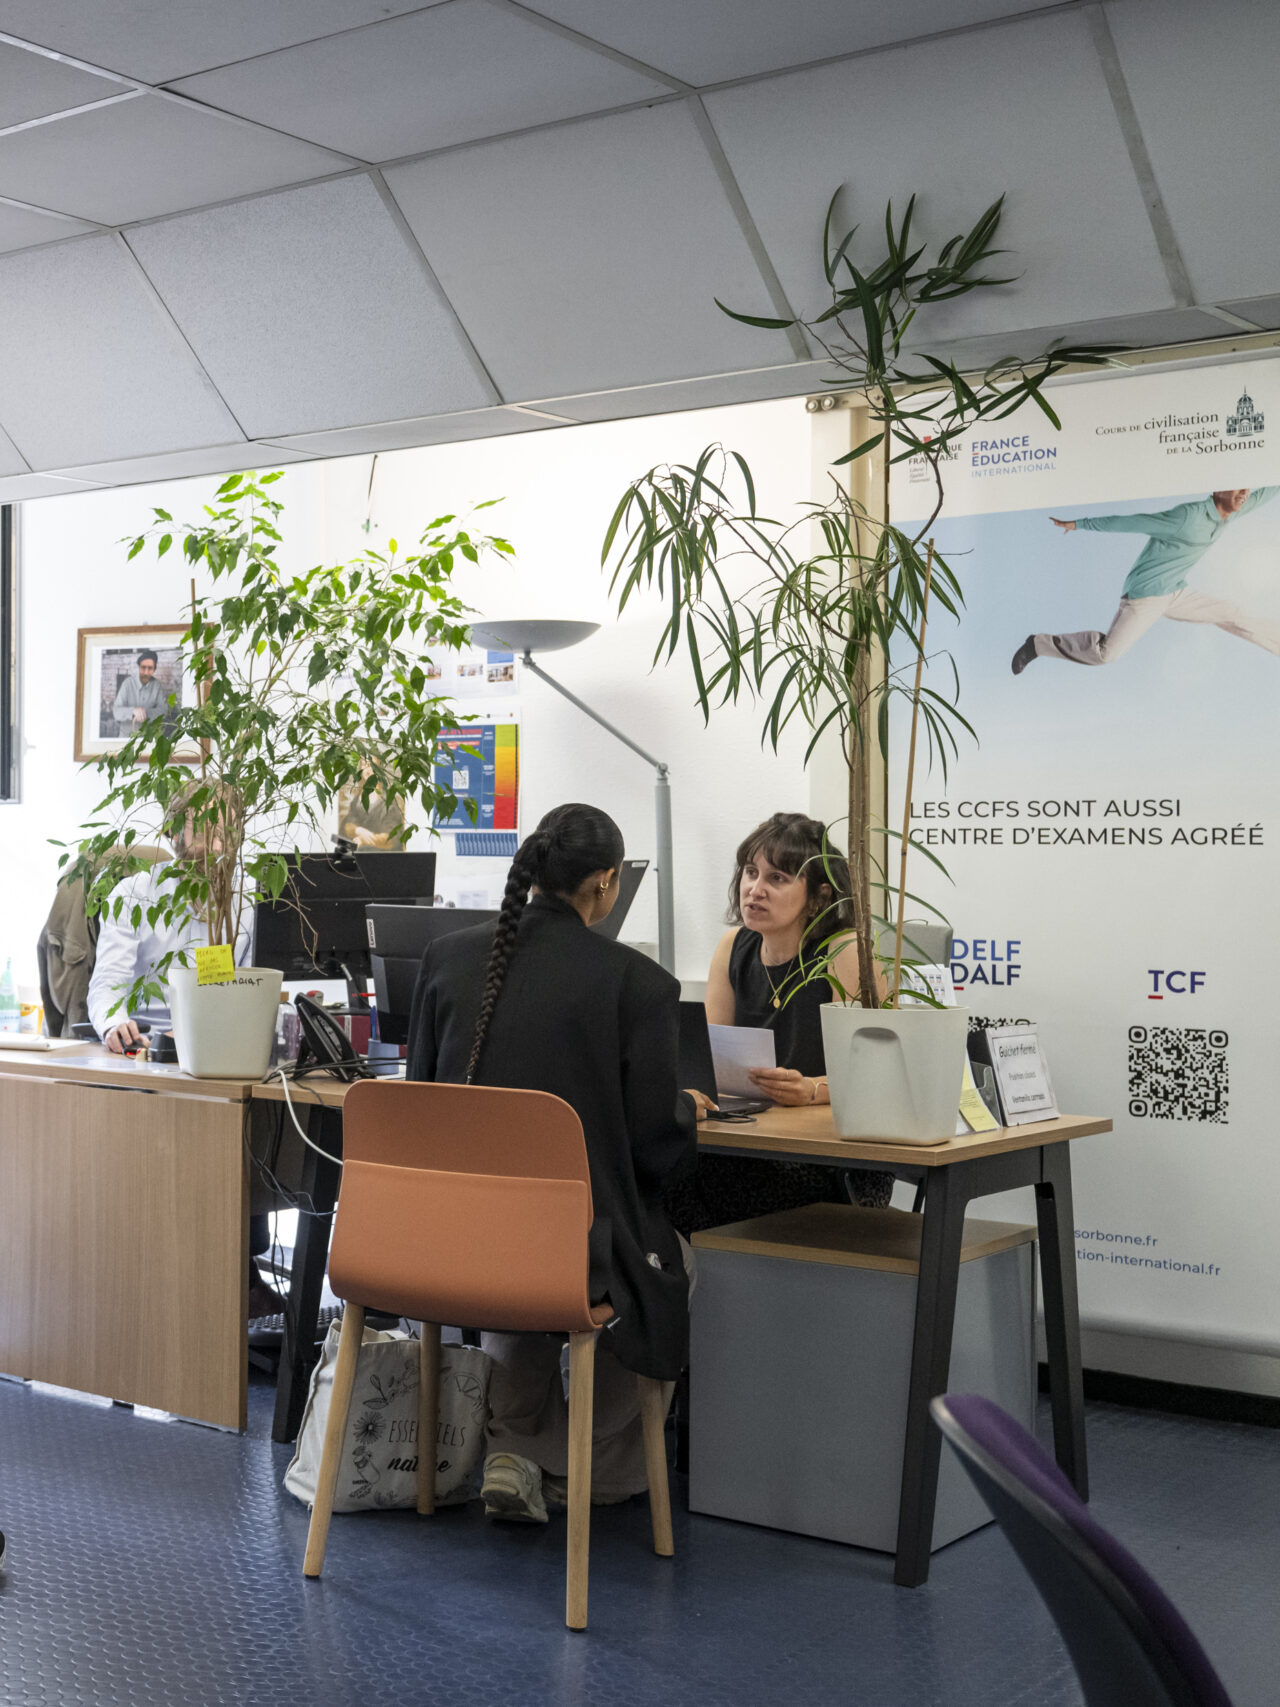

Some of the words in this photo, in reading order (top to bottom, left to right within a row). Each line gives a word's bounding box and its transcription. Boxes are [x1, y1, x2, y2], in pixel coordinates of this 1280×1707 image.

[1144, 412, 1219, 430] civilisation
[972, 436, 1029, 452] FRANCE
[1159, 427, 1220, 444] française
[1195, 439, 1265, 455] Sorbonne
[972, 462, 1056, 478] INTERNATIONAL
[910, 802, 950, 819] LES
[957, 801, 1020, 818] CCFS
[1027, 800, 1097, 818] SONT
[1103, 799, 1181, 817] AUSSI
[909, 828, 1004, 845] CENTRE
[1012, 827, 1163, 845] D’EXAMENS
[1170, 822, 1264, 846] AGRÉÉ
[951, 938, 1021, 961] DELF
[950, 963, 1021, 985] DALF
[1147, 969, 1206, 994] TCF
[1074, 1229, 1159, 1247] sorbonne.fr
[1077, 1248, 1222, 1276] tion-international.fr
[387, 1455, 453, 1473] nate
